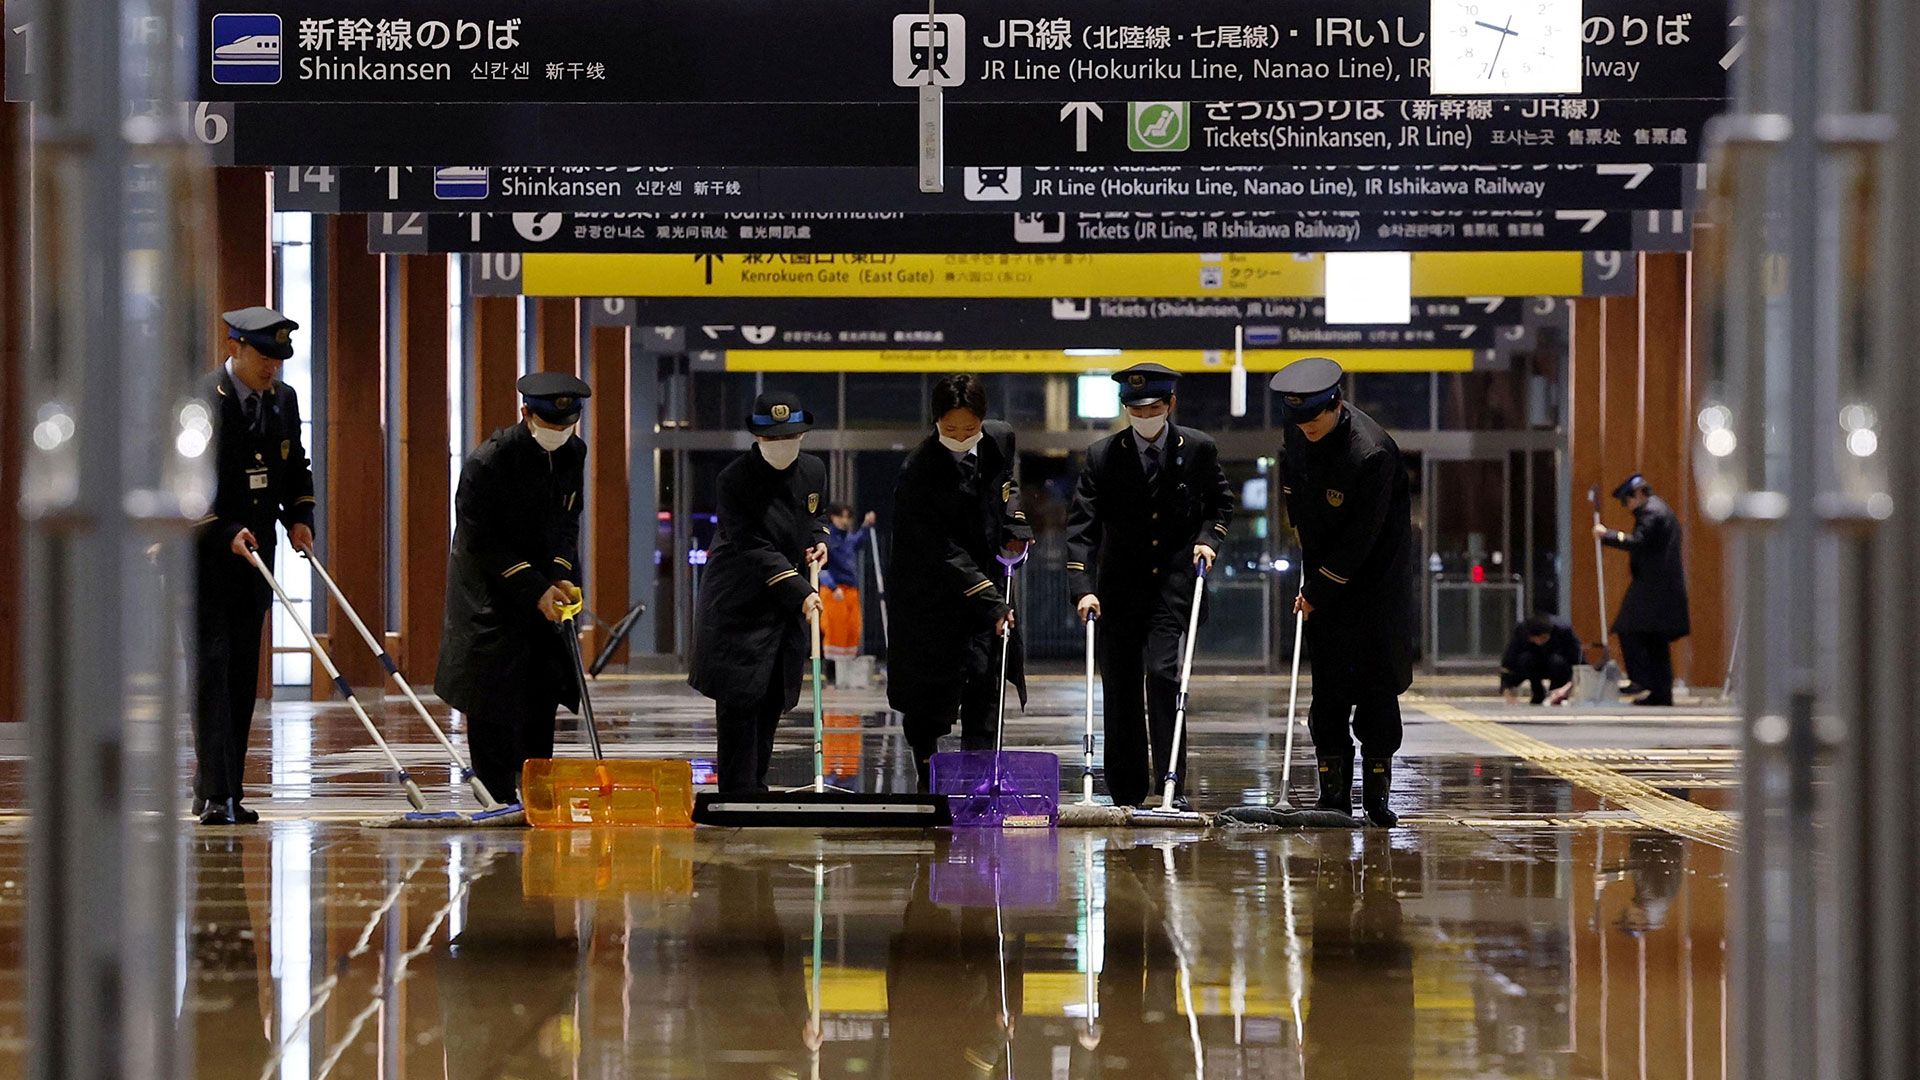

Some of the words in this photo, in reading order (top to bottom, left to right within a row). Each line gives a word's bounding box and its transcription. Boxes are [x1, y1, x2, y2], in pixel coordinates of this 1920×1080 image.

[298, 17, 522, 52] 新幹線のりば
[299, 55, 451, 81] Shinkansen
[470, 61, 530, 80] 신칸센
[545, 61, 606, 80] 新干线
[980, 60, 1006, 80] JR
[1014, 58, 1061, 80] Line
[1069, 57, 1181, 83] (Hokuriku
[1191, 57, 1244, 82] Line,
[1253, 58, 1330, 79] Nanao
[1338, 56, 1401, 82] Line),
[1409, 58, 1431, 79] IR
[1585, 55, 1640, 82] lway
[1202, 125, 1392, 151] Tickets(Shinkansen,
[1397, 125, 1420, 147] JR
[1426, 124, 1472, 149] Line)
[1490, 128, 1555, 146] 표사는곳
[1567, 128, 1622, 146] 售票处
[501, 175, 621, 196] Shinkansen
[635, 180, 682, 196] 신칸센
[693, 180, 742, 196] 新干线
[1032, 179, 1053, 196] JR
[1058, 178, 1096, 196] Line
[1101, 177, 1190, 198] (Hokuriku
[1195, 177, 1238, 197] Line,
[1244, 178, 1305, 196] Nanao
[1310, 177, 1357, 198] Line),
[1365, 177, 1383, 195] IR
[1388, 176, 1469, 195] Ishikawa
[1474, 176, 1546, 199] Railway
[1076, 220, 1130, 240] Tickets
[1134, 220, 1157, 241] (JR
[1161, 220, 1198, 241] Line,
[1202, 220, 1218, 238] IR
[1221, 219, 1291, 239] Ishikawa
[1294, 219, 1361, 243] Railway)
[741, 268, 814, 283] Kenrokuen
[817, 268, 850, 284] Gate
[858, 269, 893, 284] (East
[896, 269, 935, 284] Gate)
